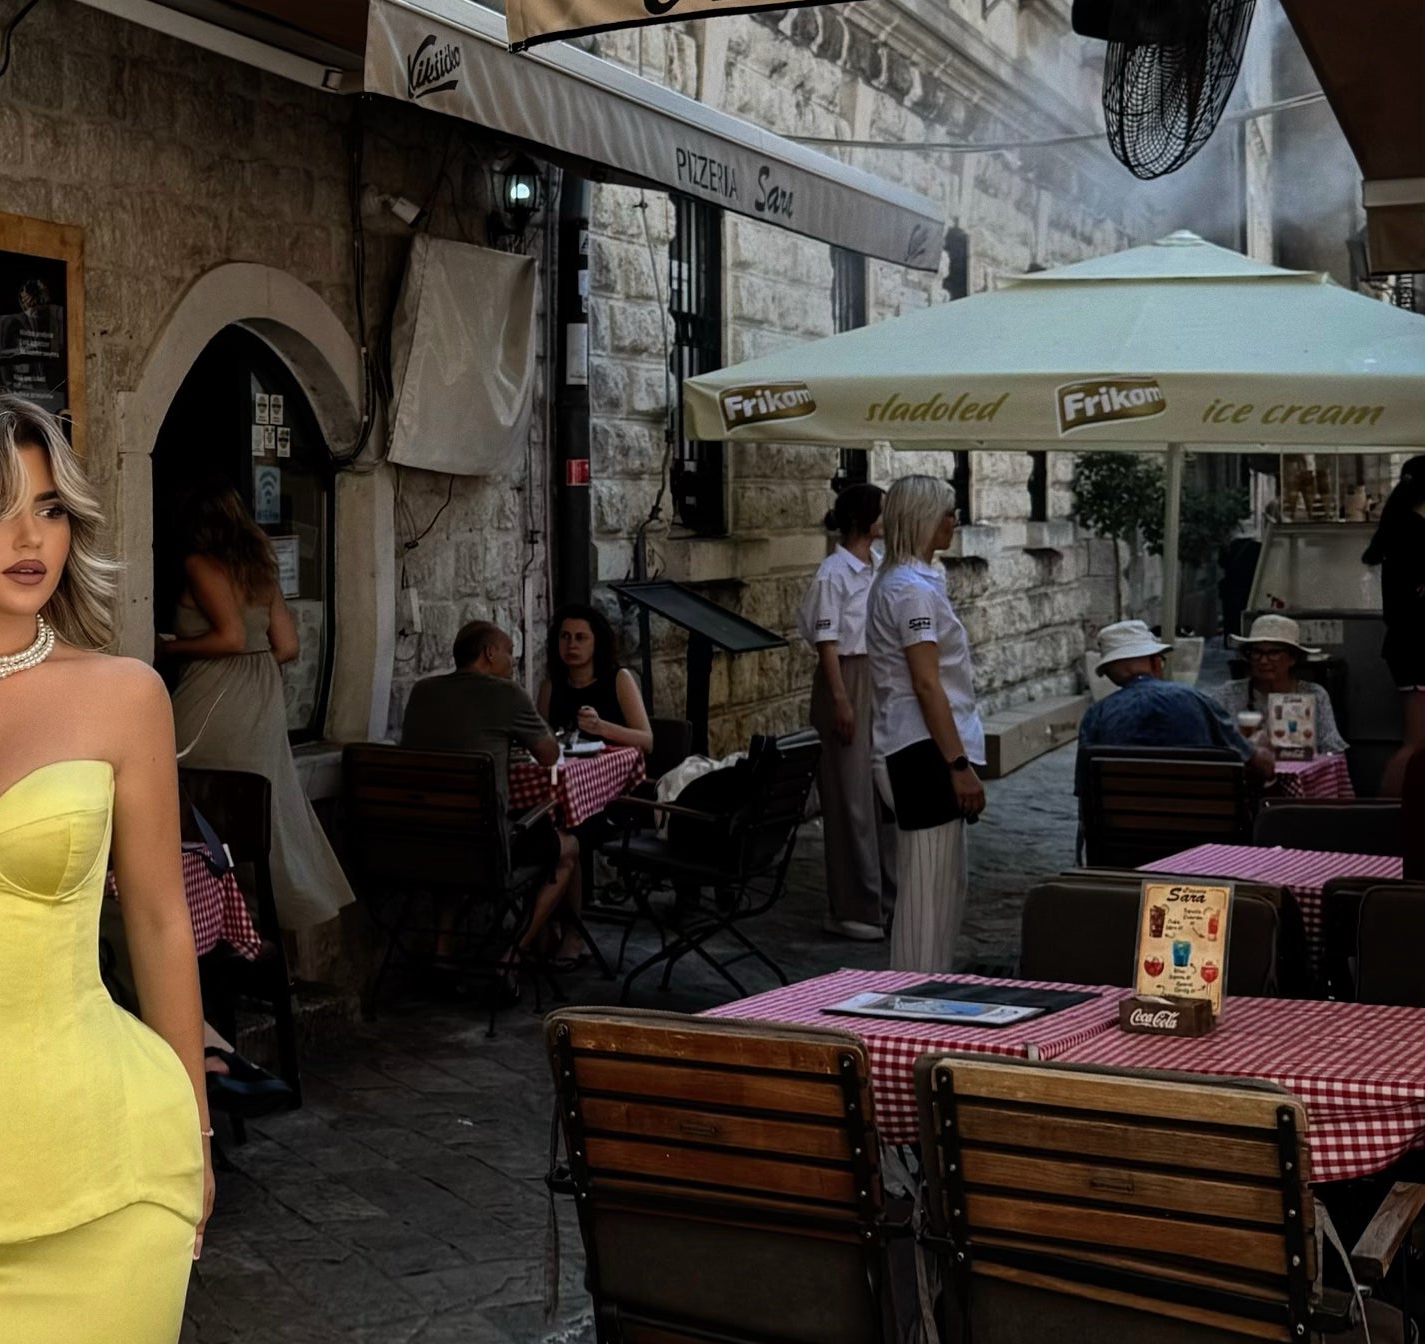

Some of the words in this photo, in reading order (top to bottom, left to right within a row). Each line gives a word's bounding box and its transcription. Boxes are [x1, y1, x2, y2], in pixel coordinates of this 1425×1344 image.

[676, 147, 739, 202] PIZZERIA
[724, 388, 815, 424] Frikom
[863, 392, 1010, 424] sladoled
[1062, 379, 1163, 423] Frikom
[1202, 397, 1251, 425] ice
[1260, 404, 1386, 428] cream
[1166, 887, 1207, 904] Sara
